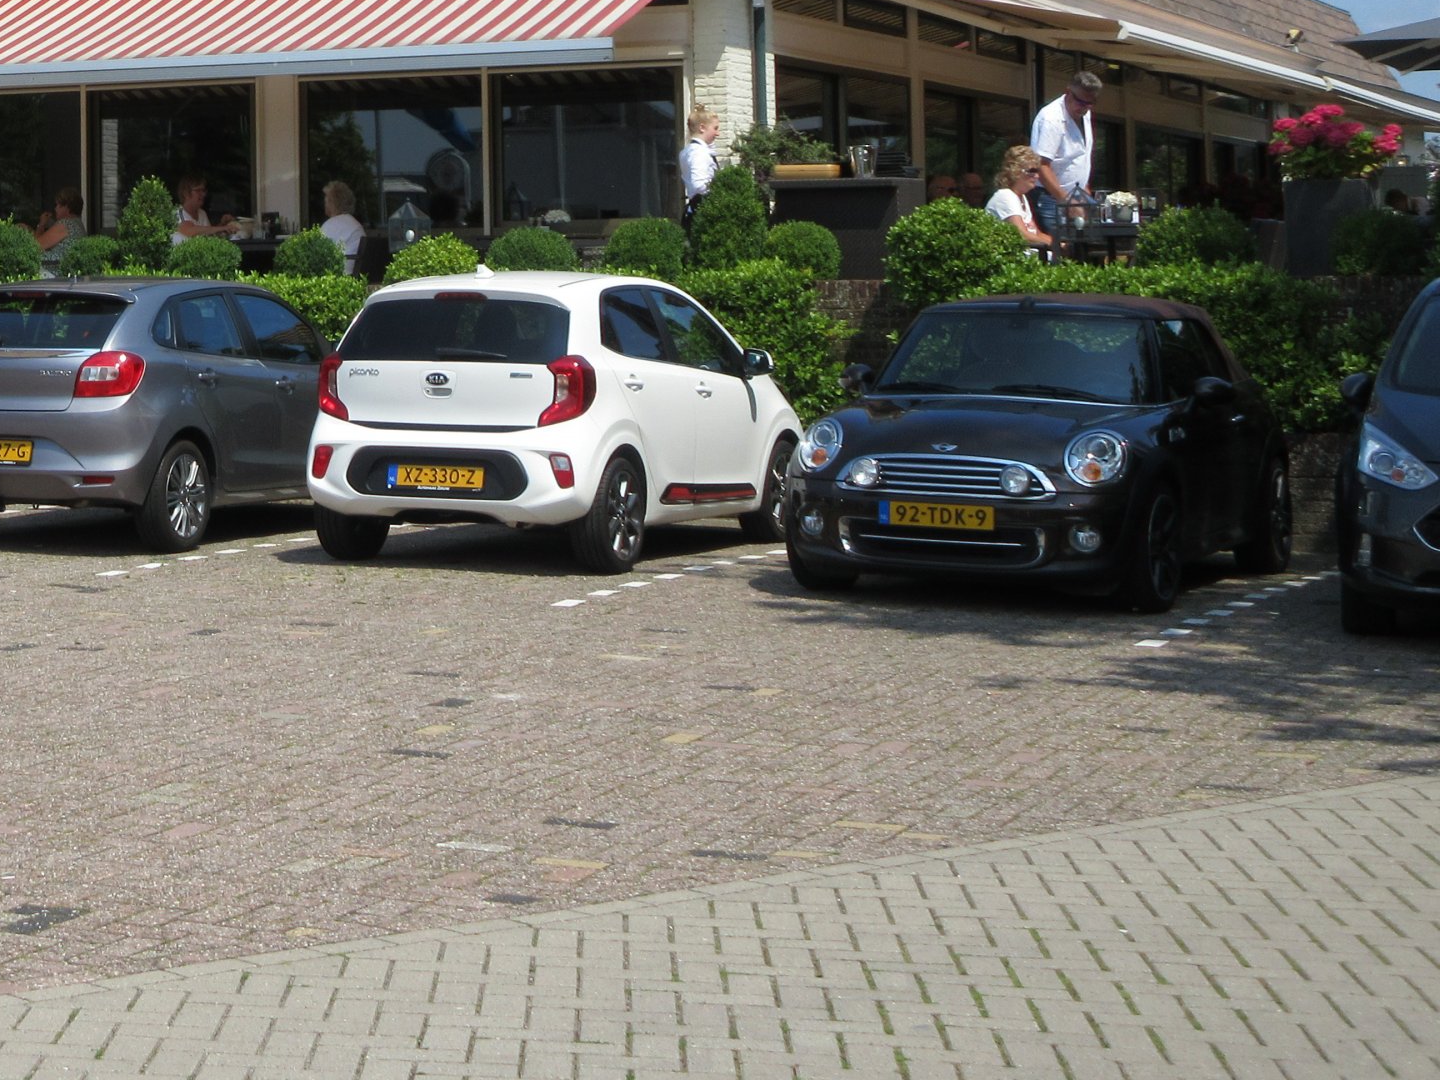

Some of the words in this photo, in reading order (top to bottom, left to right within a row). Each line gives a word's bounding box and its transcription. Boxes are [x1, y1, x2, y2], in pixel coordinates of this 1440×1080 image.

[349, 367, 380, 378] picanto
[427, 375, 446, 385] KIA
[403, 466, 476, 485] XZ-330-Z
[895, 504, 987, 526] 92-TDK-9
